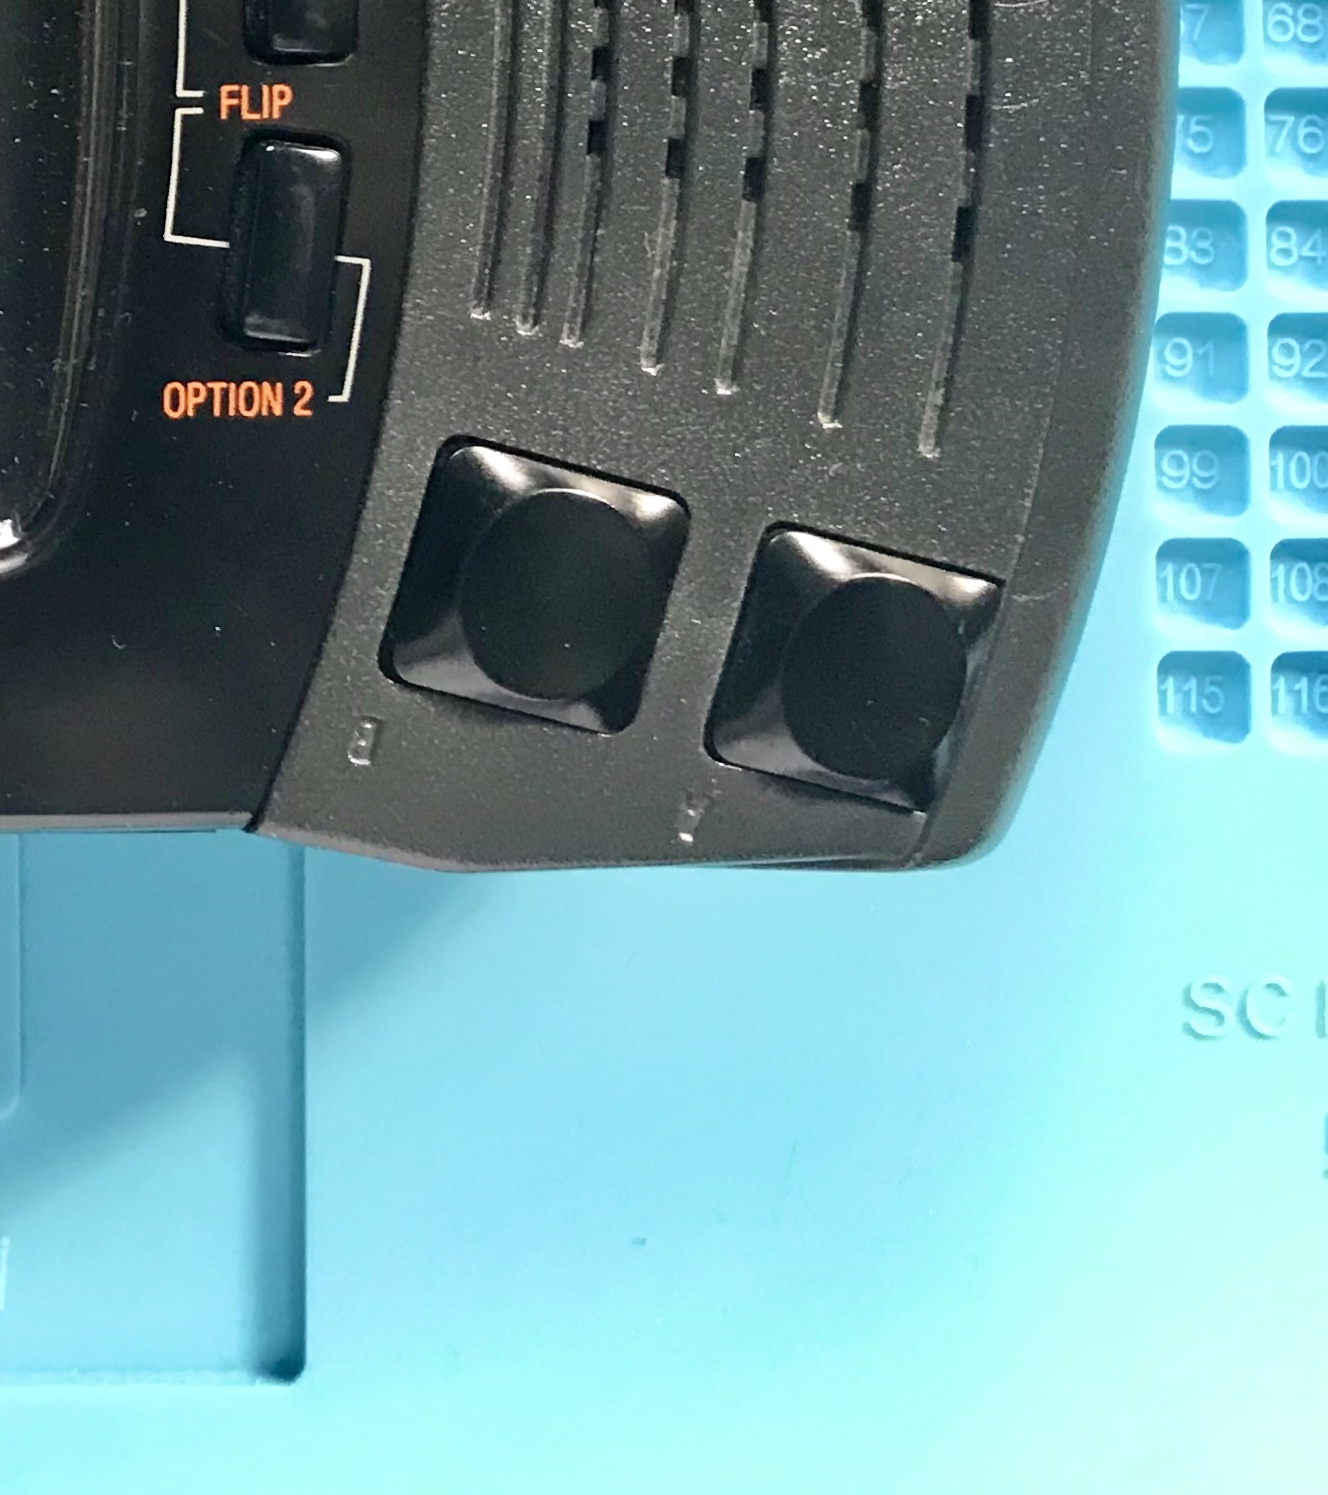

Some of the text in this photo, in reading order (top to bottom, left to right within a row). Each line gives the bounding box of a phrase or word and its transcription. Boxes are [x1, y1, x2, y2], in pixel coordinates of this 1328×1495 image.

[1267, 3, 1324, 42] 68
[219, 84, 294, 120] FLIP
[1268, 114, 1325, 155] 76
[1270, 226, 1326, 266] 84
[1164, 337, 1214, 377] 91
[1272, 337, 1327, 378] 92
[162, 380, 314, 419] OPTION 2
[1161, 449, 1219, 489] 99
[1159, 562, 1222, 601] 107
[1160, 675, 1225, 714] 115
